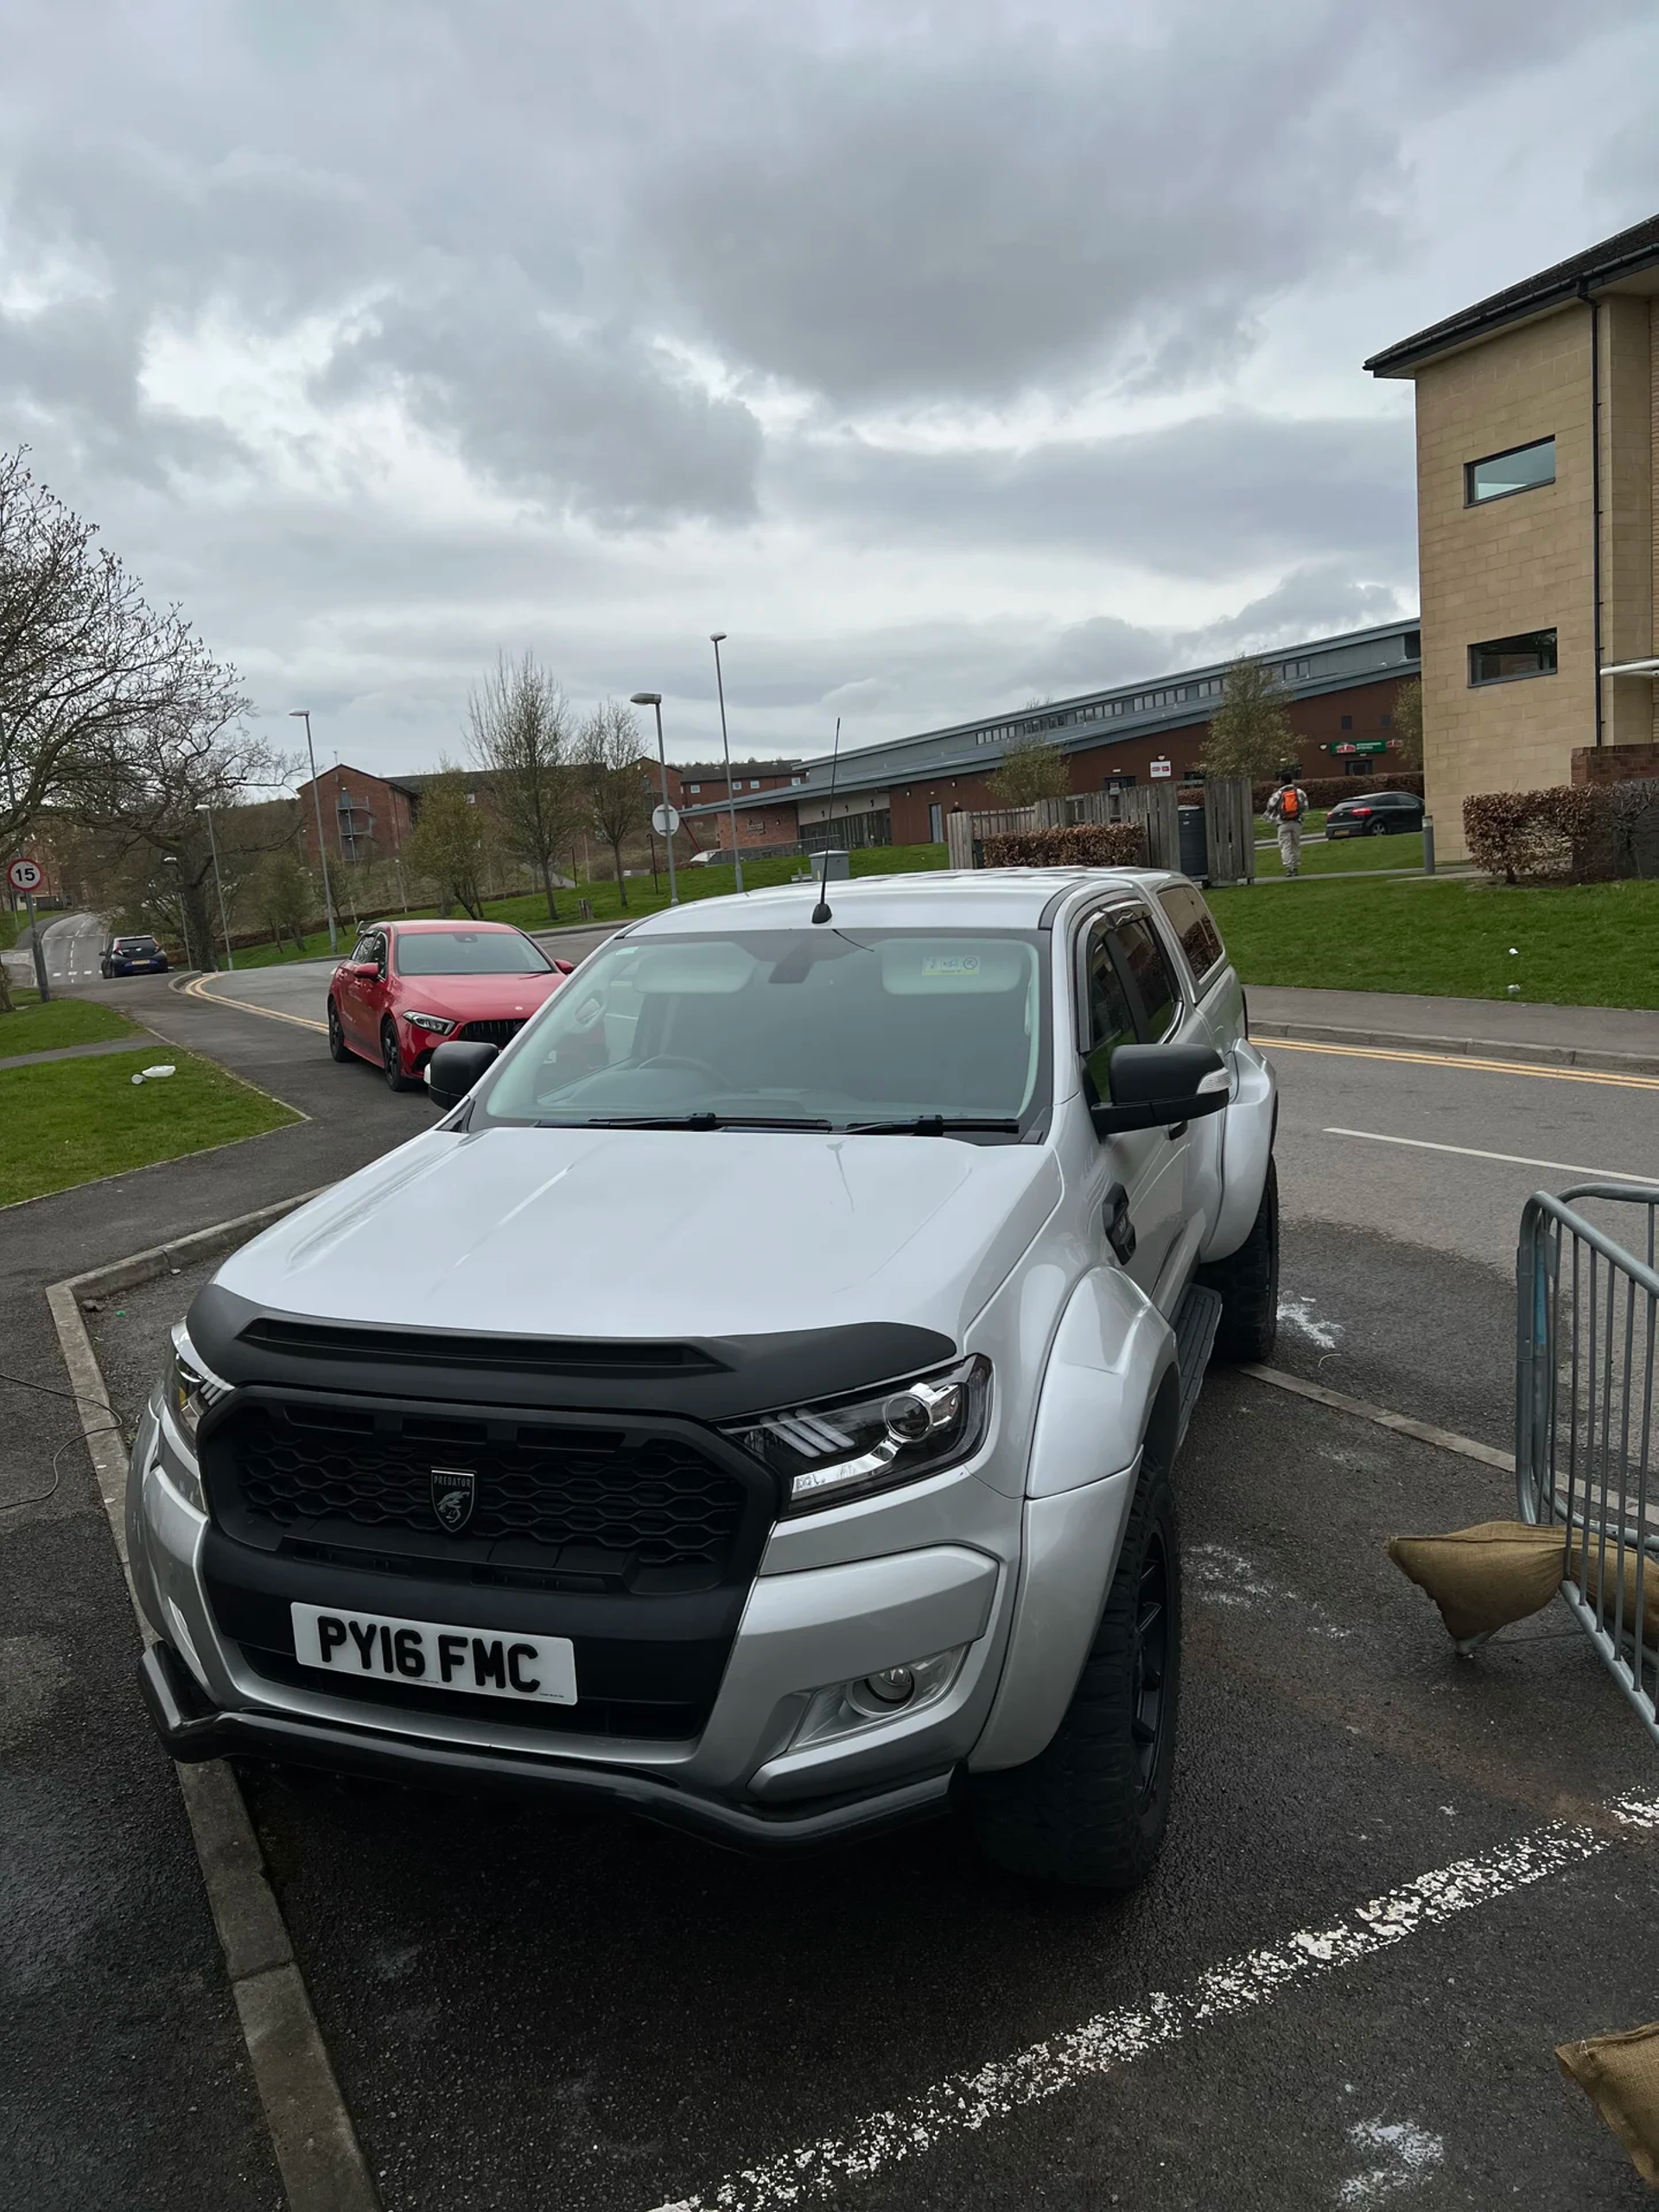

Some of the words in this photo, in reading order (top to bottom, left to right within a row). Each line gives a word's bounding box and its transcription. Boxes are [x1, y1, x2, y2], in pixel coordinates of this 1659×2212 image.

[16, 868, 35, 881] 15
[433, 1475, 472, 1489] PREDATOR
[317, 1615, 426, 1678] PY16
[437, 1634, 541, 1694] FMC
